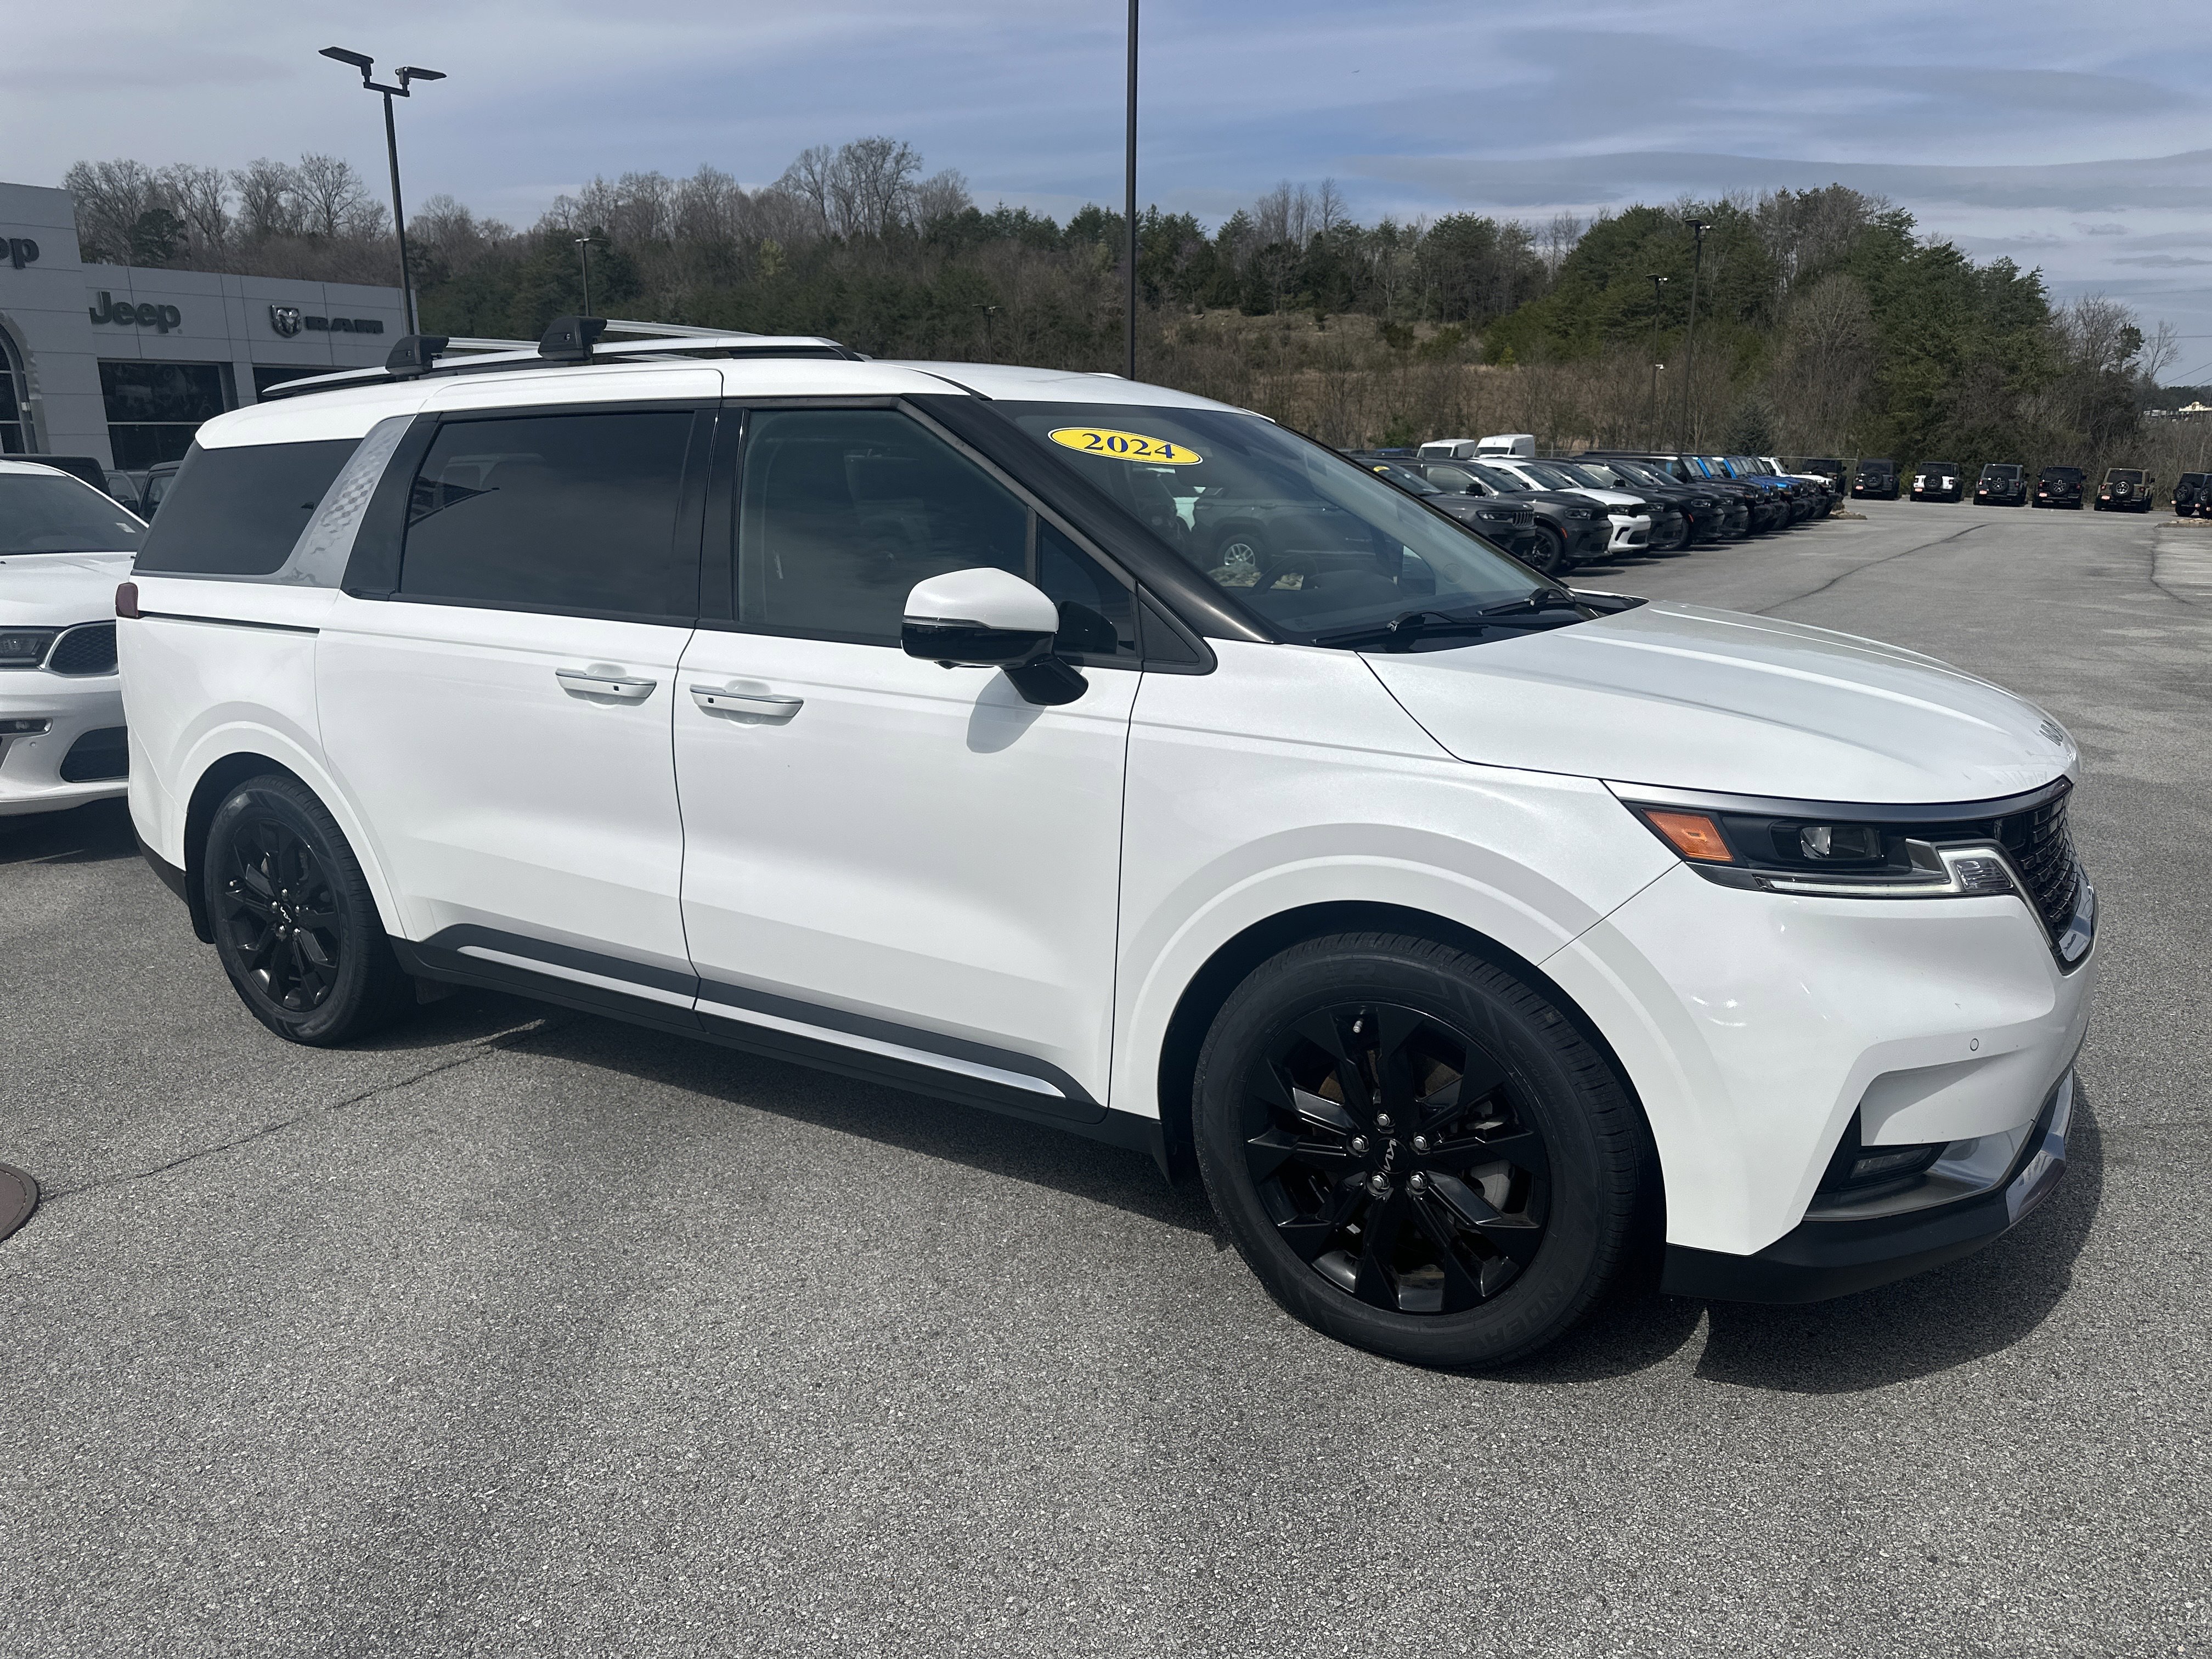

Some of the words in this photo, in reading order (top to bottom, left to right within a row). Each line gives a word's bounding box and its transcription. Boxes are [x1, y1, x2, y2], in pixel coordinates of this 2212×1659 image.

[89, 291, 181, 334] Jeep
[305, 315, 384, 334] RAM
[1081, 433, 1176, 459] 2024
